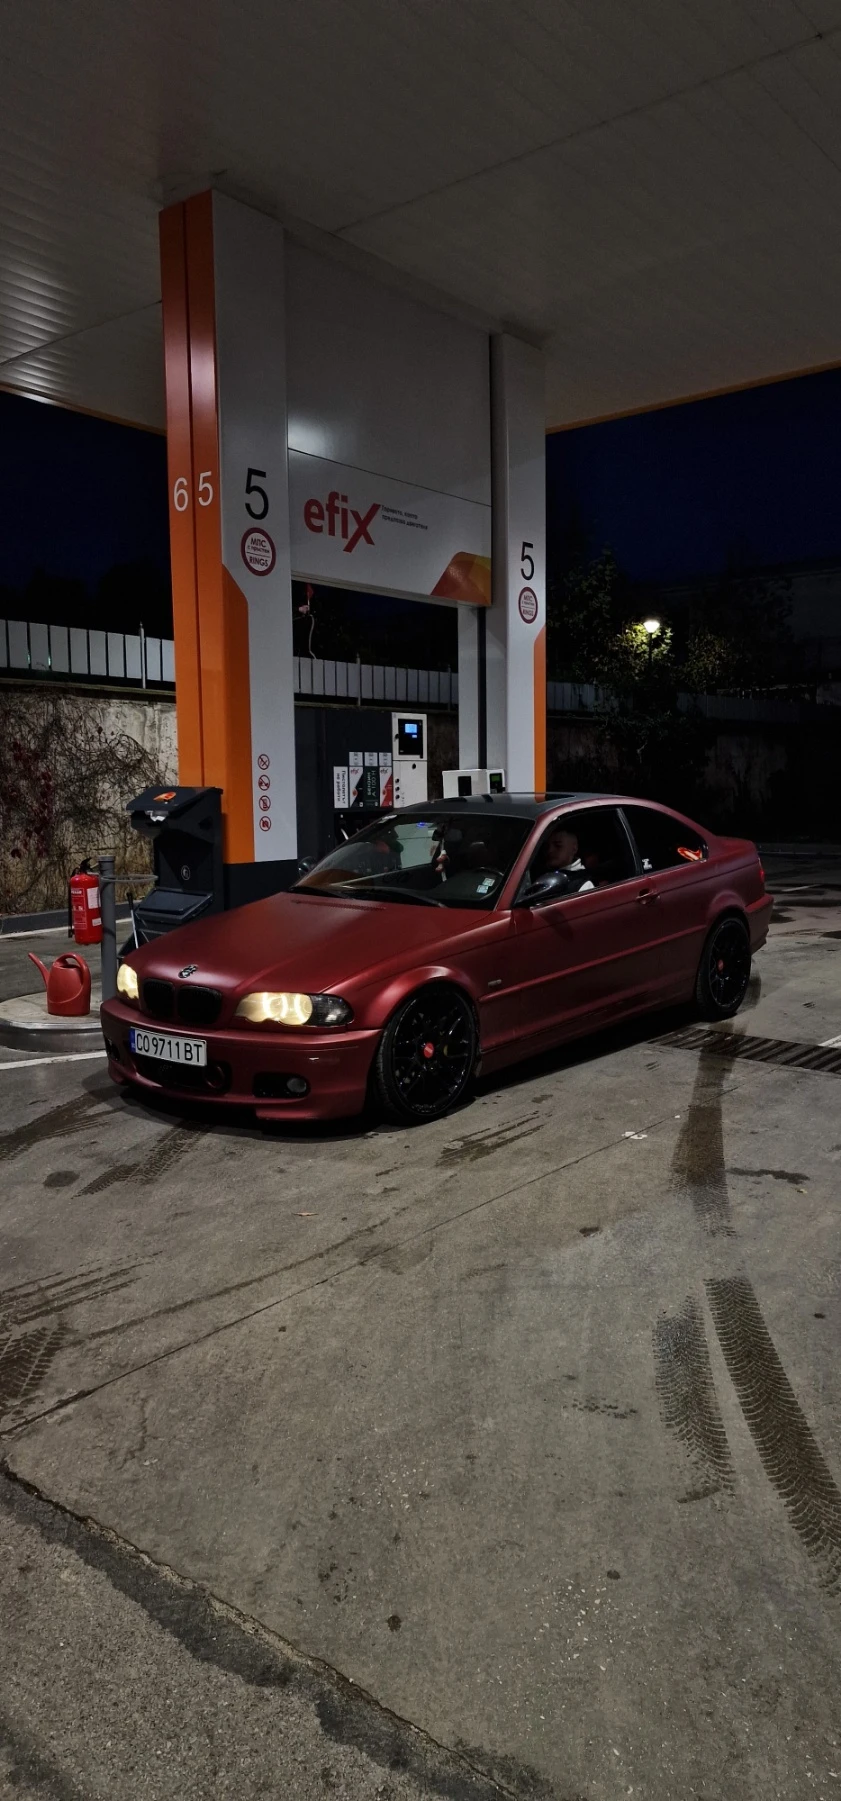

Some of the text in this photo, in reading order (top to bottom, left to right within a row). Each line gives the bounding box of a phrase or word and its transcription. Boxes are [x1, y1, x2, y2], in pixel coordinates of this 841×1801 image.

[173, 476, 189, 512] 6
[198, 470, 213, 506] 5
[244, 467, 269, 520] 5
[303, 491, 381, 553] efix
[250, 537, 266, 548] МПС
[249, 556, 269, 568] RINGS
[520, 541, 534, 581] 5
[151, 1037, 180, 1060] 9711
[184, 1042, 203, 1063] BT
